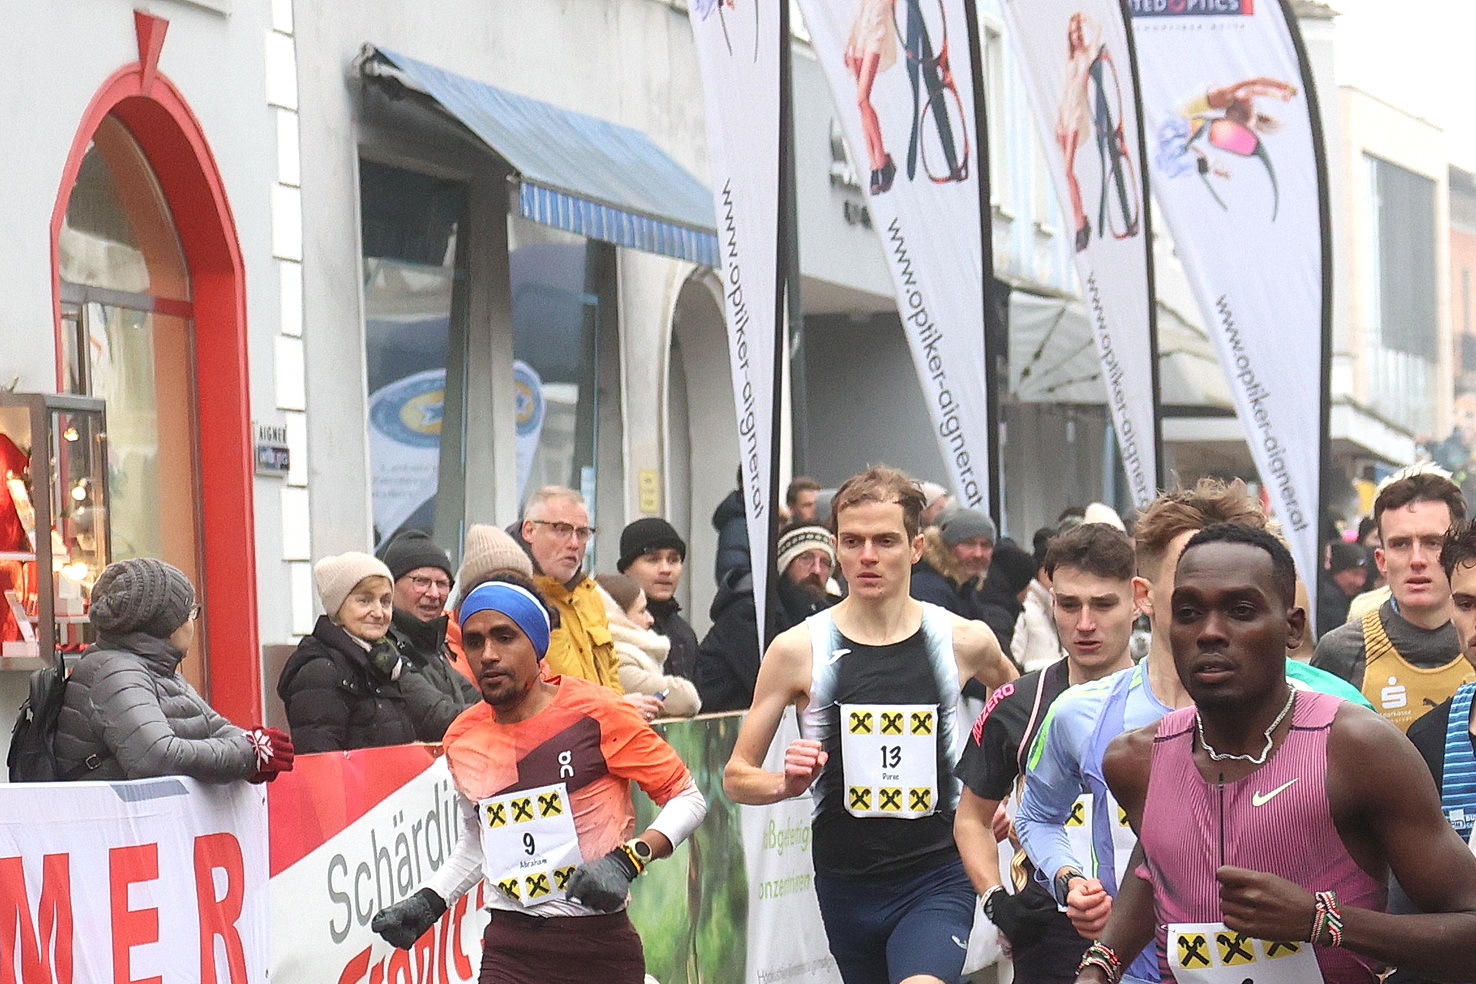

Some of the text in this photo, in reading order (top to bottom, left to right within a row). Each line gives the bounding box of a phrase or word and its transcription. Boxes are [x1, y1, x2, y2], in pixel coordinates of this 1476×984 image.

[722, 177, 764, 520] www.optiker-aigner.at
[887, 216, 984, 509] www.optiker-aigner.at
[1087, 270, 1149, 508] www.optiker-aigner.a
[1215, 294, 1309, 533] www.optiker-aigner.at
[880, 745, 902, 768] 13
[972, 682, 1016, 748] ADIZERO
[520, 858, 547, 869] Abraham
[523, 832, 535, 855] 9
